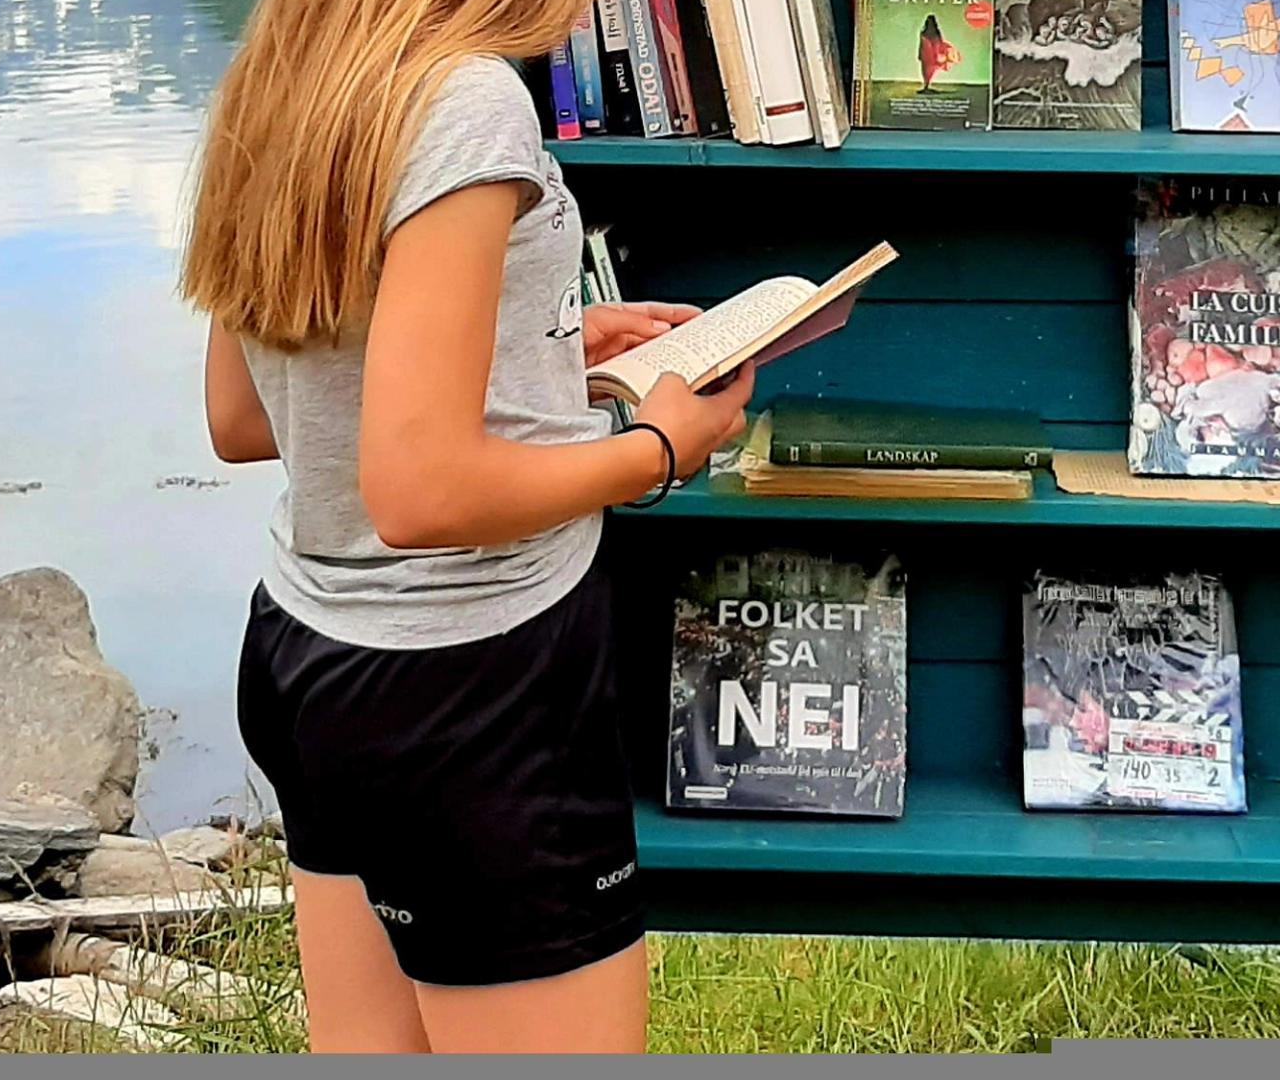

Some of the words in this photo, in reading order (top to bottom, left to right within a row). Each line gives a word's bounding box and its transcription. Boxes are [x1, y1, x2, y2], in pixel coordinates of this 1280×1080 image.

[1192, 291, 1222, 312] LA
[718, 599, 870, 631] FOLKET
[767, 639, 819, 668] SA
[717, 679, 860, 751] NEI
